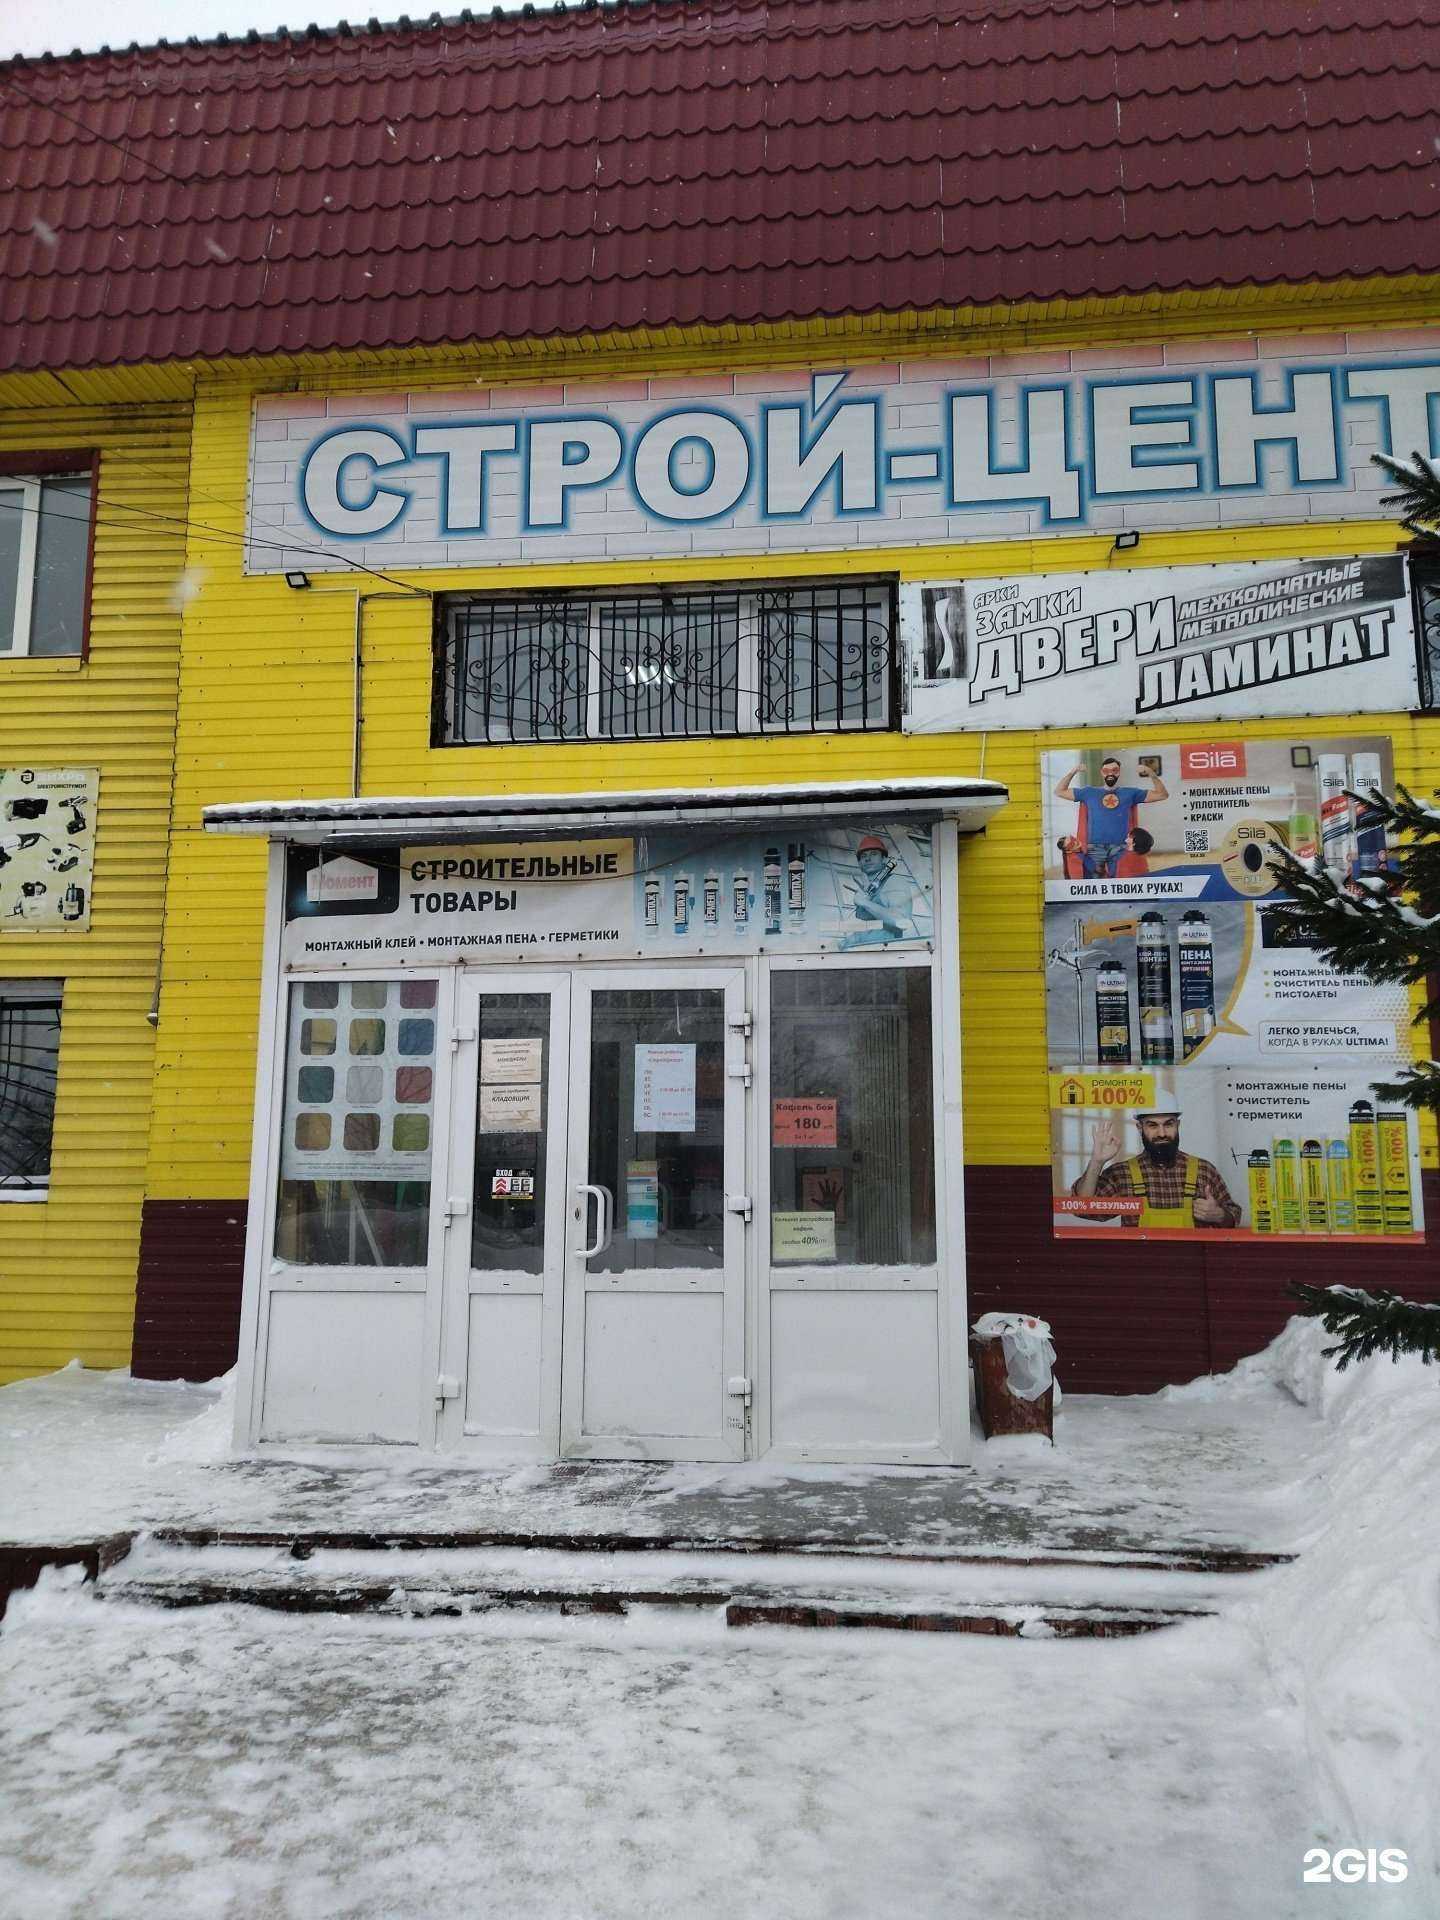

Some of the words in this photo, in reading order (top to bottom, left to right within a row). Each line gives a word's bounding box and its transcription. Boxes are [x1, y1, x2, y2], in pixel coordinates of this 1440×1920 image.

[974, 584, 1019, 609] АРКИ
[1177, 561, 1362, 622] МЕЖКОМНАТНЫЕ
[976, 586, 1081, 636] ЗАМКИ
[1180, 581, 1364, 642] МЕТАЛЛИЧЕСКИЕ
[969, 596, 1177, 704] ДВЕРИ
[1136, 606, 1395, 713] ЛАМИНАТ
[1189, 786, 1244, 797] МОНТАЖНЫЕ
[1246, 785, 1270, 795] ПЕНЫ
[1190, 799, 1249, 810] УПЛОТНИТЕЛЬ
[1190, 813, 1224, 822] КРАСКИ
[410, 853, 618, 882] СТРОИТЕЛЬНЫЕ
[1070, 885, 1098, 896] СИЛА
[1101, 885, 1108, 894] В
[1111, 884, 1144, 894] ТВОИХ
[1147, 882, 1183, 894] РУКАХ!
[410, 891, 517, 914] ТОВАРЫ
[305, 937, 382, 952] МОНТАЖНЫЙ
[385, 934, 416, 949] КЛЕЙ
[427, 934, 502, 947] МОНТАЖНАЯ
[505, 933, 538, 945] ПЕНА
[549, 930, 619, 943] ГЕРМЕТИКИ
[1180, 950, 1211, 960] ПЕНА
[1274, 980, 1340, 988] ОЧИСТИТЕЛЬ
[1268, 1027, 1300, 1035] ЛЕГКО
[1303, 1027, 1359, 1035] УВЛЕЧЬСЯ,
[1268, 1038, 1300, 1047] КОГДА
[1303, 1038, 1309, 1046] В
[1312, 1038, 1343, 1046] РУКАХ
[1346, 1038, 1388, 1046] ULTIMA!
[1091, 1079, 1128, 1087] ремонт
[1235, 1082, 1309, 1090] монтажные
[1312, 1081, 1347, 1090] пены
[1091, 1088, 1146, 1105] 100%
[1236, 1096, 1311, 1105] очиститель
[1237, 1111, 1303, 1121] герметики
[794, 1118, 821, 1129] 180
[1061, 1201, 1087, 1210] 100%
[1089, 1200, 1140, 1210] РЕЗУЛЬТАТ
